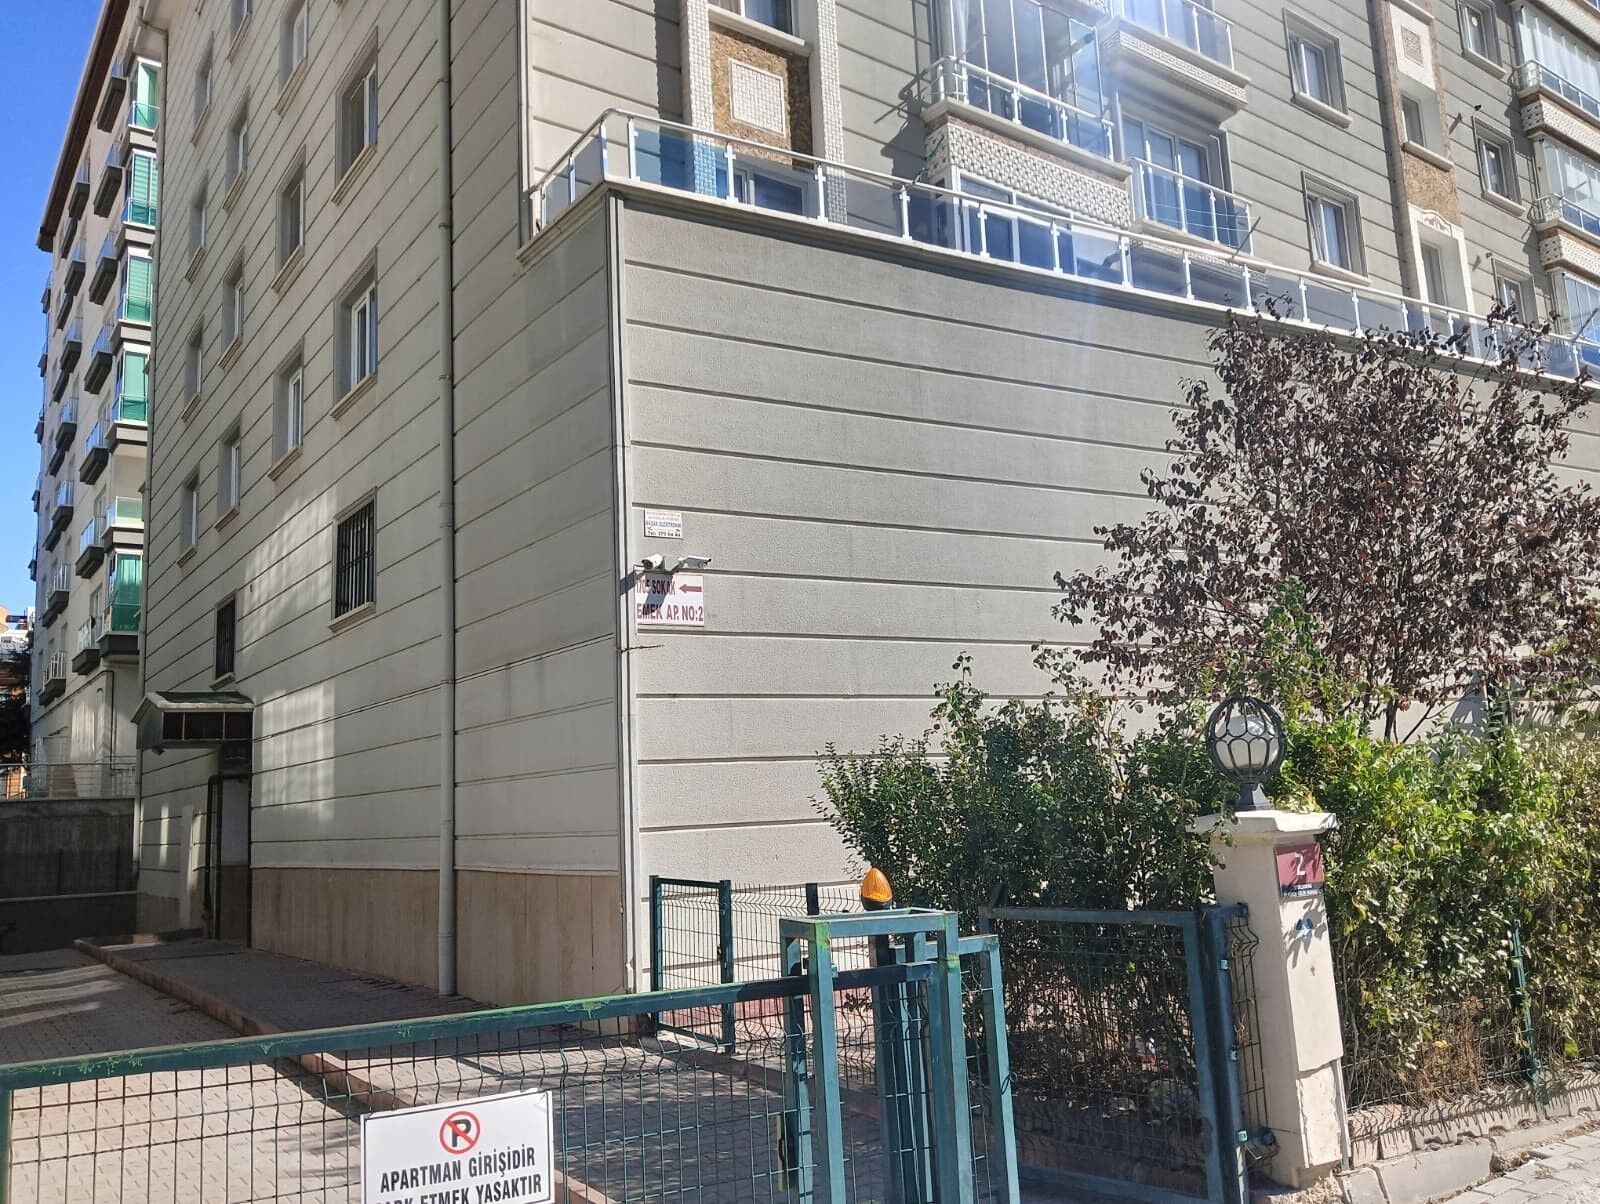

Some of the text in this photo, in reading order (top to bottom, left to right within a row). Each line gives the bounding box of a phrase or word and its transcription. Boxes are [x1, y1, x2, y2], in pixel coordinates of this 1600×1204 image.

[652, 580, 676, 595] SOKAK
[636, 603, 663, 620] EMEK
[681, 605, 704, 621] NO:2
[1294, 851, 1306, 876] 2
[380, 1143, 536, 1193] APARTMAN GİRİŞİDİR
[475, 1173, 542, 1204] YASAKTIR
